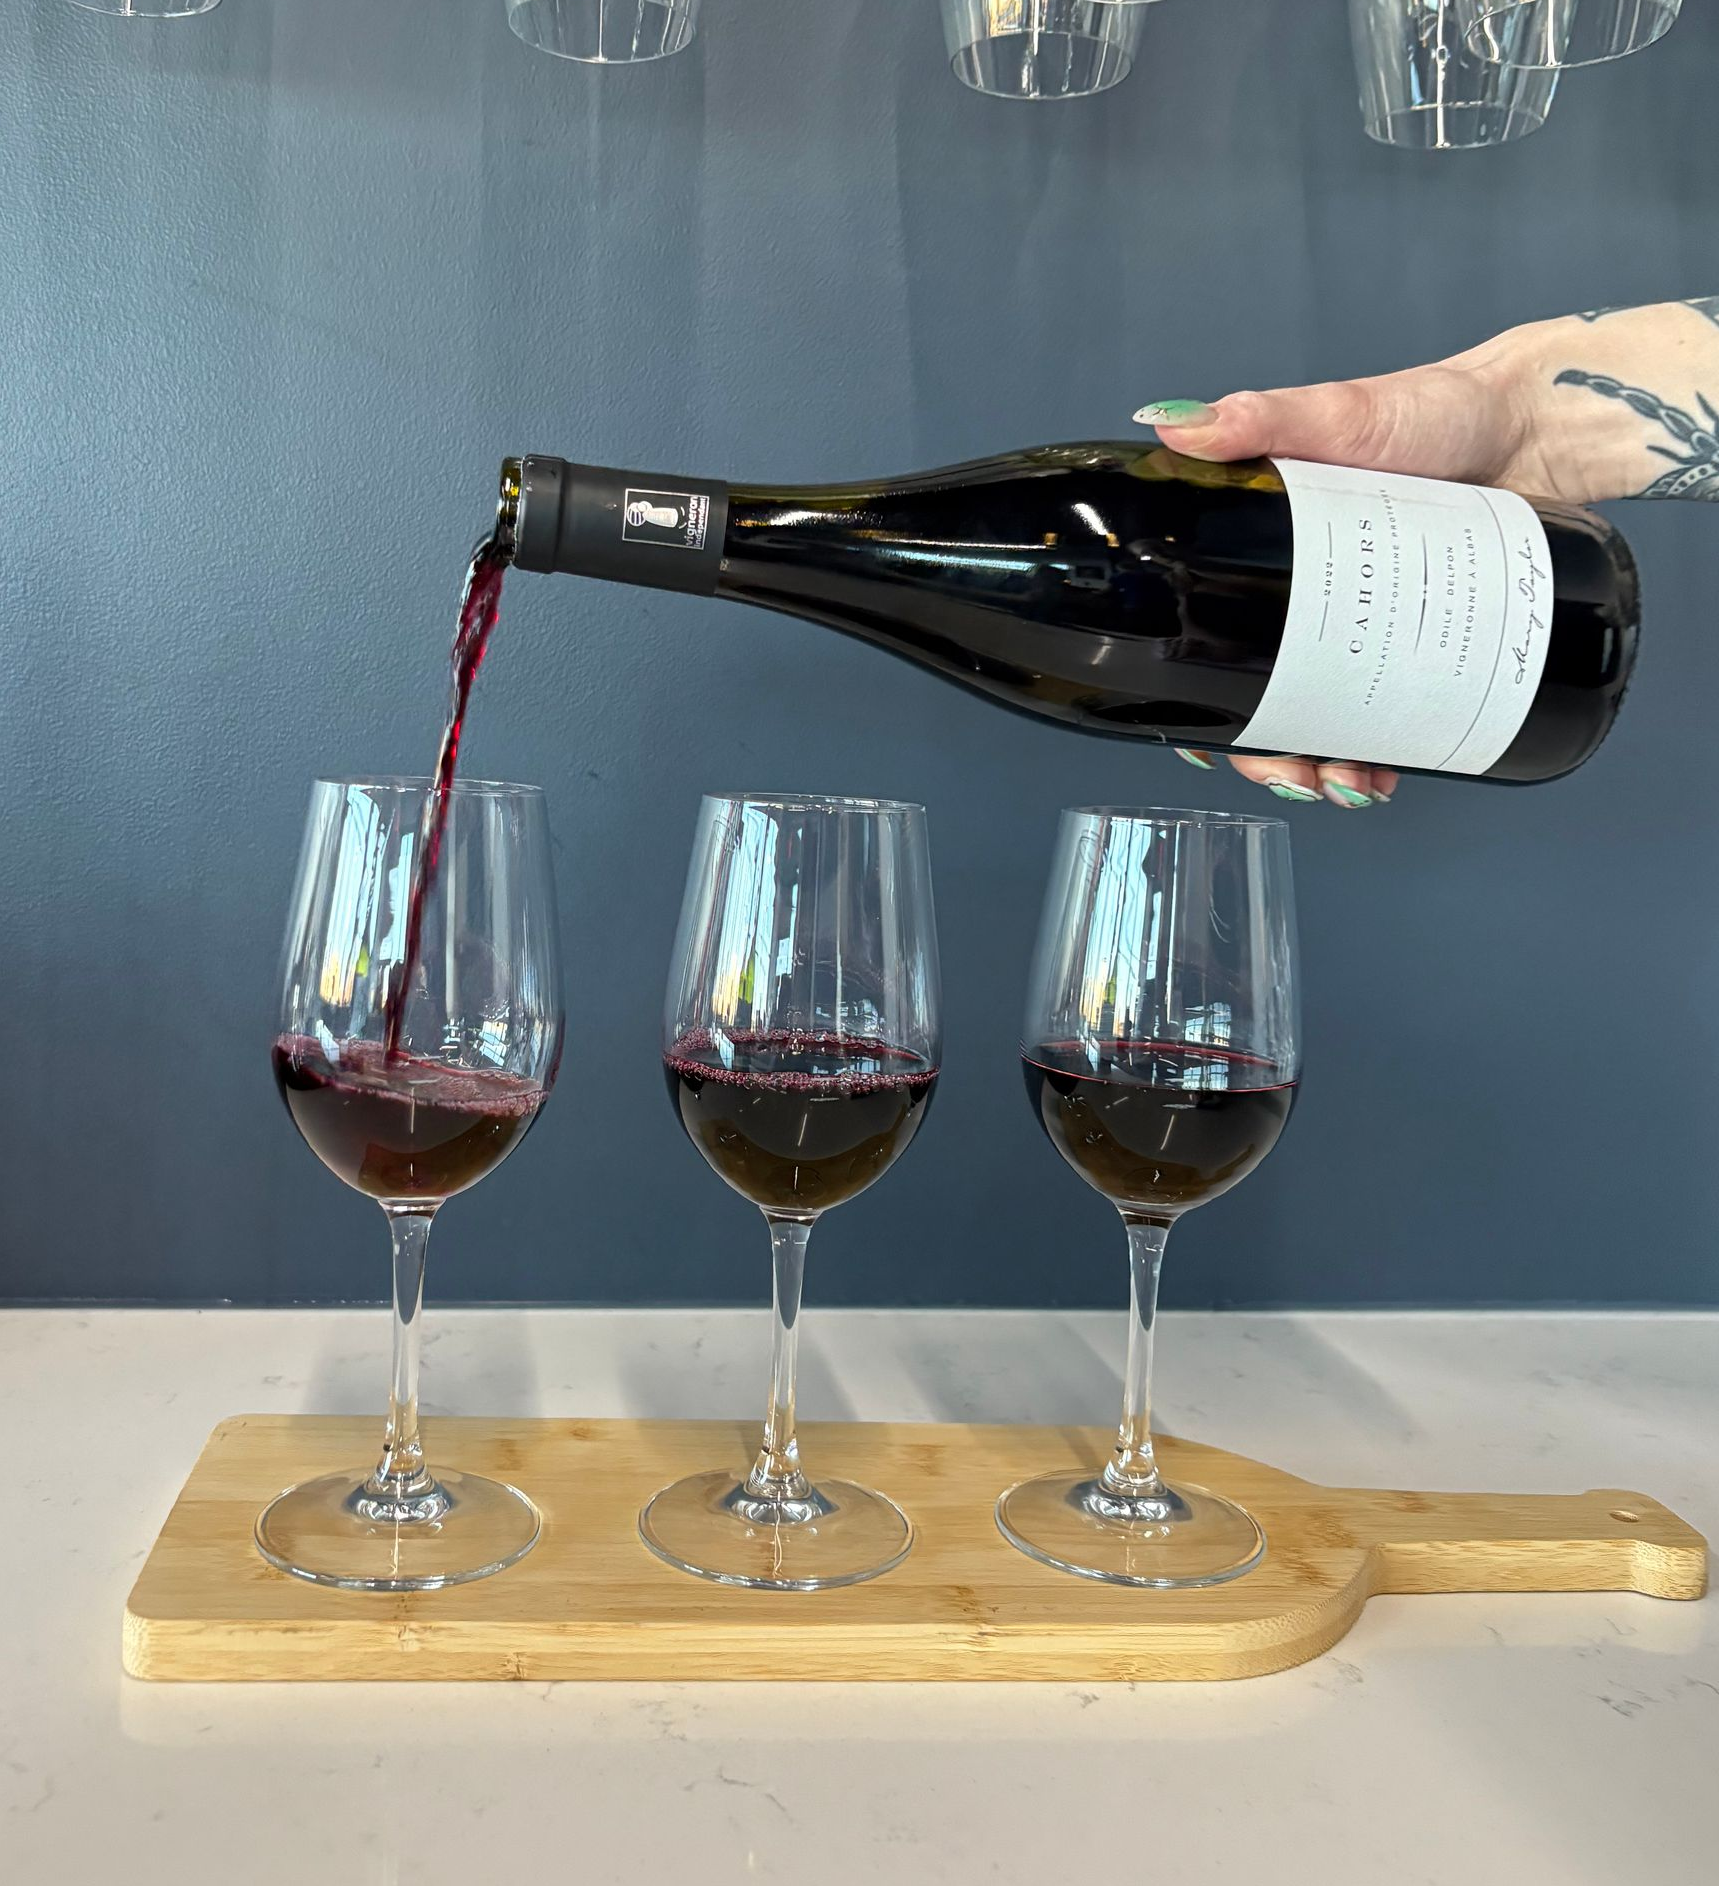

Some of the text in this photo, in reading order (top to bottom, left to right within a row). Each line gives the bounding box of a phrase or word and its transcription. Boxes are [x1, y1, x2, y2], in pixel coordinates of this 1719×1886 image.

[684, 496, 698, 546] vigneron
[1323, 561, 1334, 596] 2022
[1349, 518, 1375, 654] CAHORS
[1364, 621, 1393, 706] APPELLATION
[1390, 544, 1401, 613] D'ORIGINE
[1440, 546, 1455, 648] ODILE DELPON
[1455, 528, 1477, 677] VIGNERONNE À ALBAS
[1512, 538, 1546, 685] Mary Taylor
